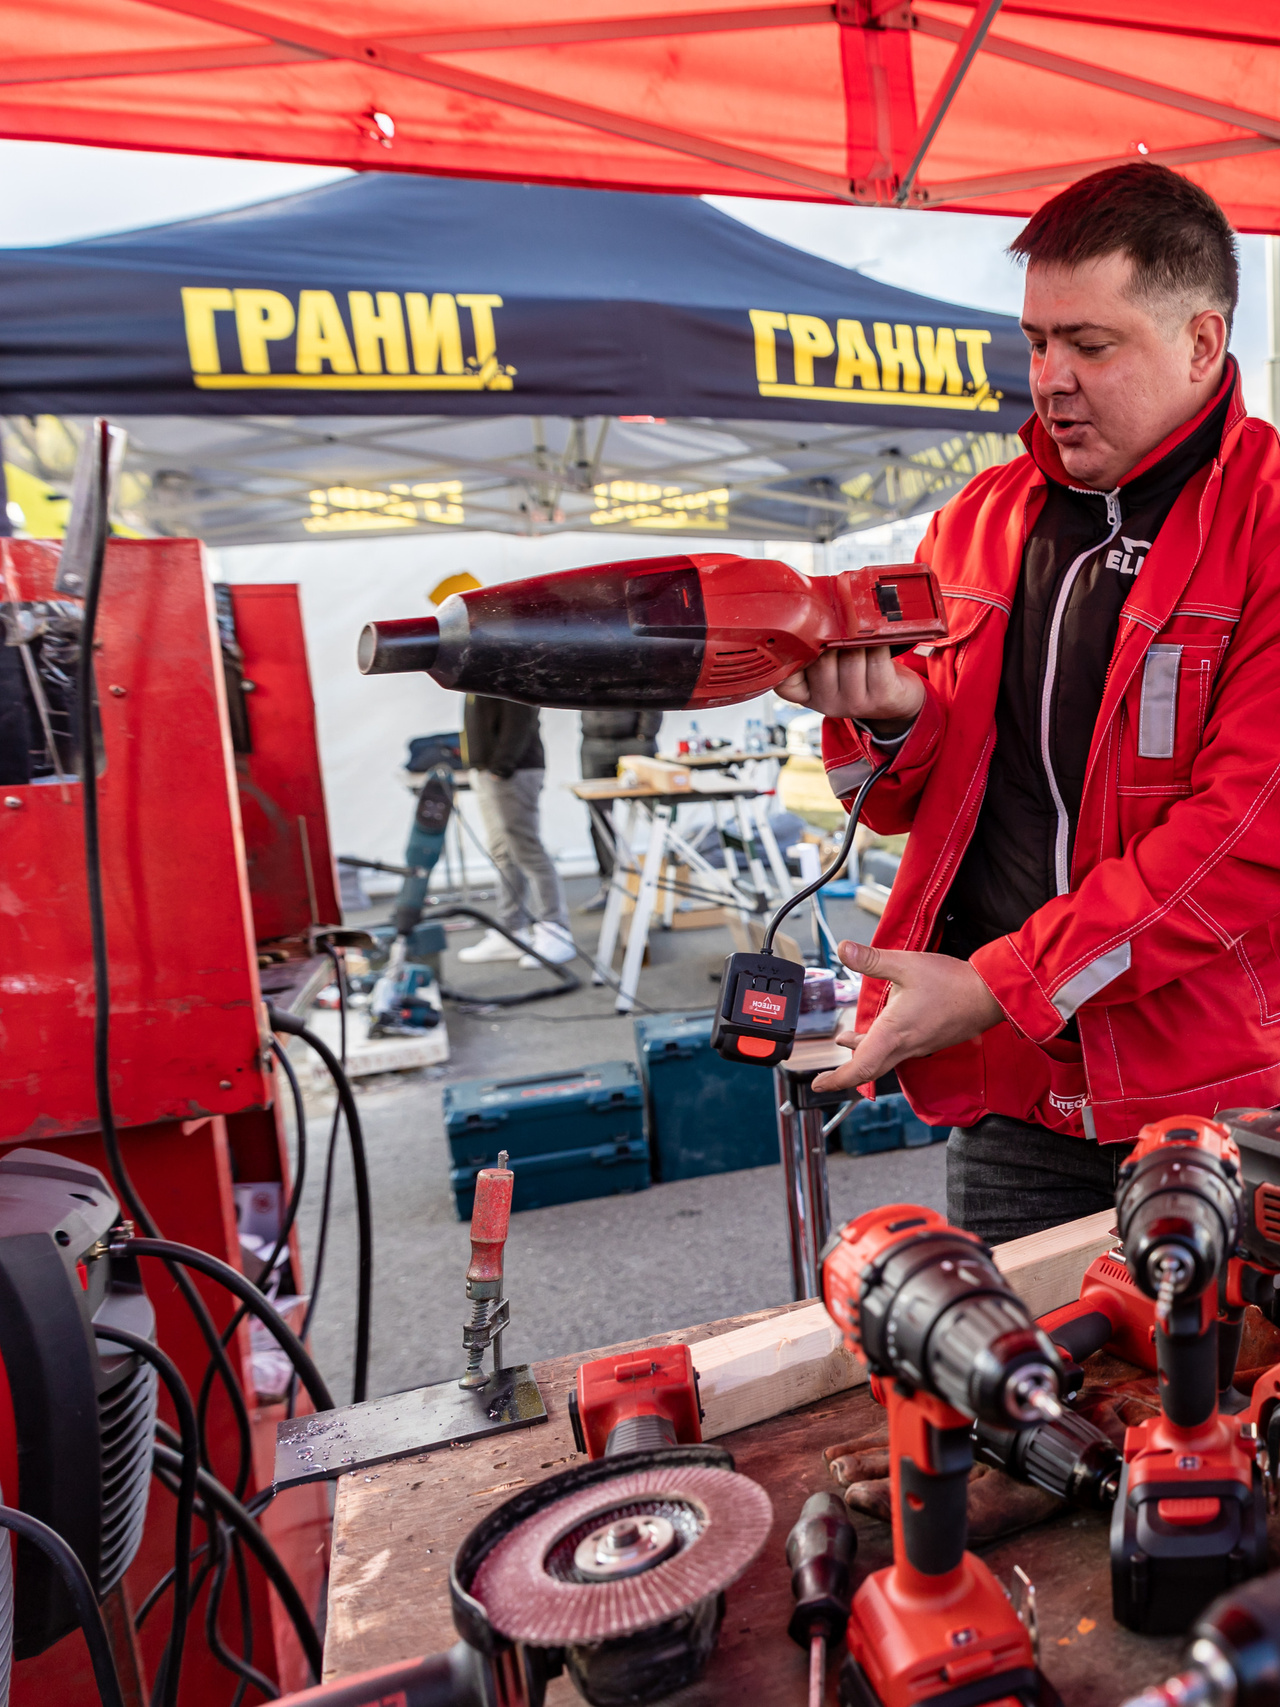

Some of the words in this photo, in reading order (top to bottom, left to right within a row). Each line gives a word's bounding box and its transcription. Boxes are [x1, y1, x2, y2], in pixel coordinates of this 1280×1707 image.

[181, 287, 504, 375] ГРАНИТ
[748, 309, 993, 396] ГРАНИТ
[1105, 549, 1145, 576] ELI
[752, 1000, 781, 1012] ELITECH
